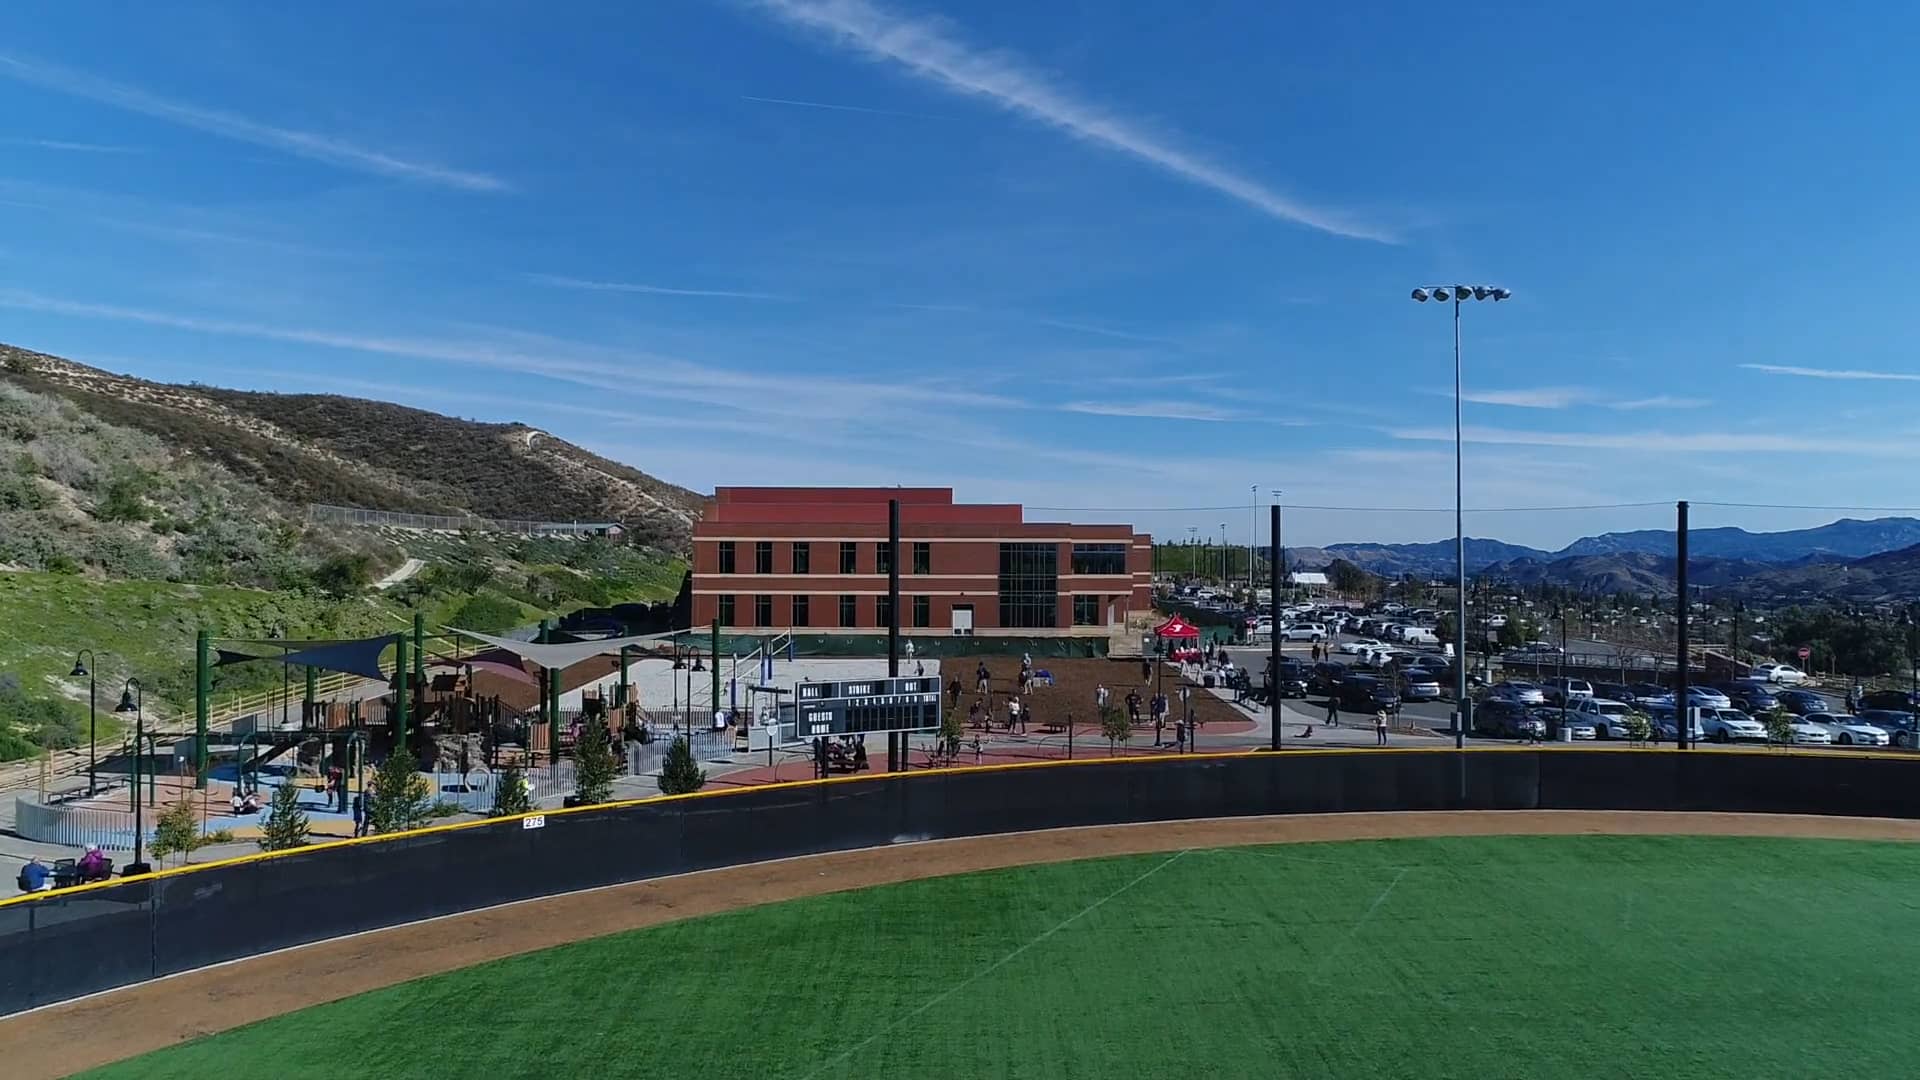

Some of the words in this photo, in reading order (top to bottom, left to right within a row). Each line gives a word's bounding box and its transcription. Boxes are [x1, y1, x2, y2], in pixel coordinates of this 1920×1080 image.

[848, 684, 871, 695] STRIKE
[904, 681, 917, 692] OUT
[802, 687, 818, 697] BALL
[525, 817, 543, 827] 275
